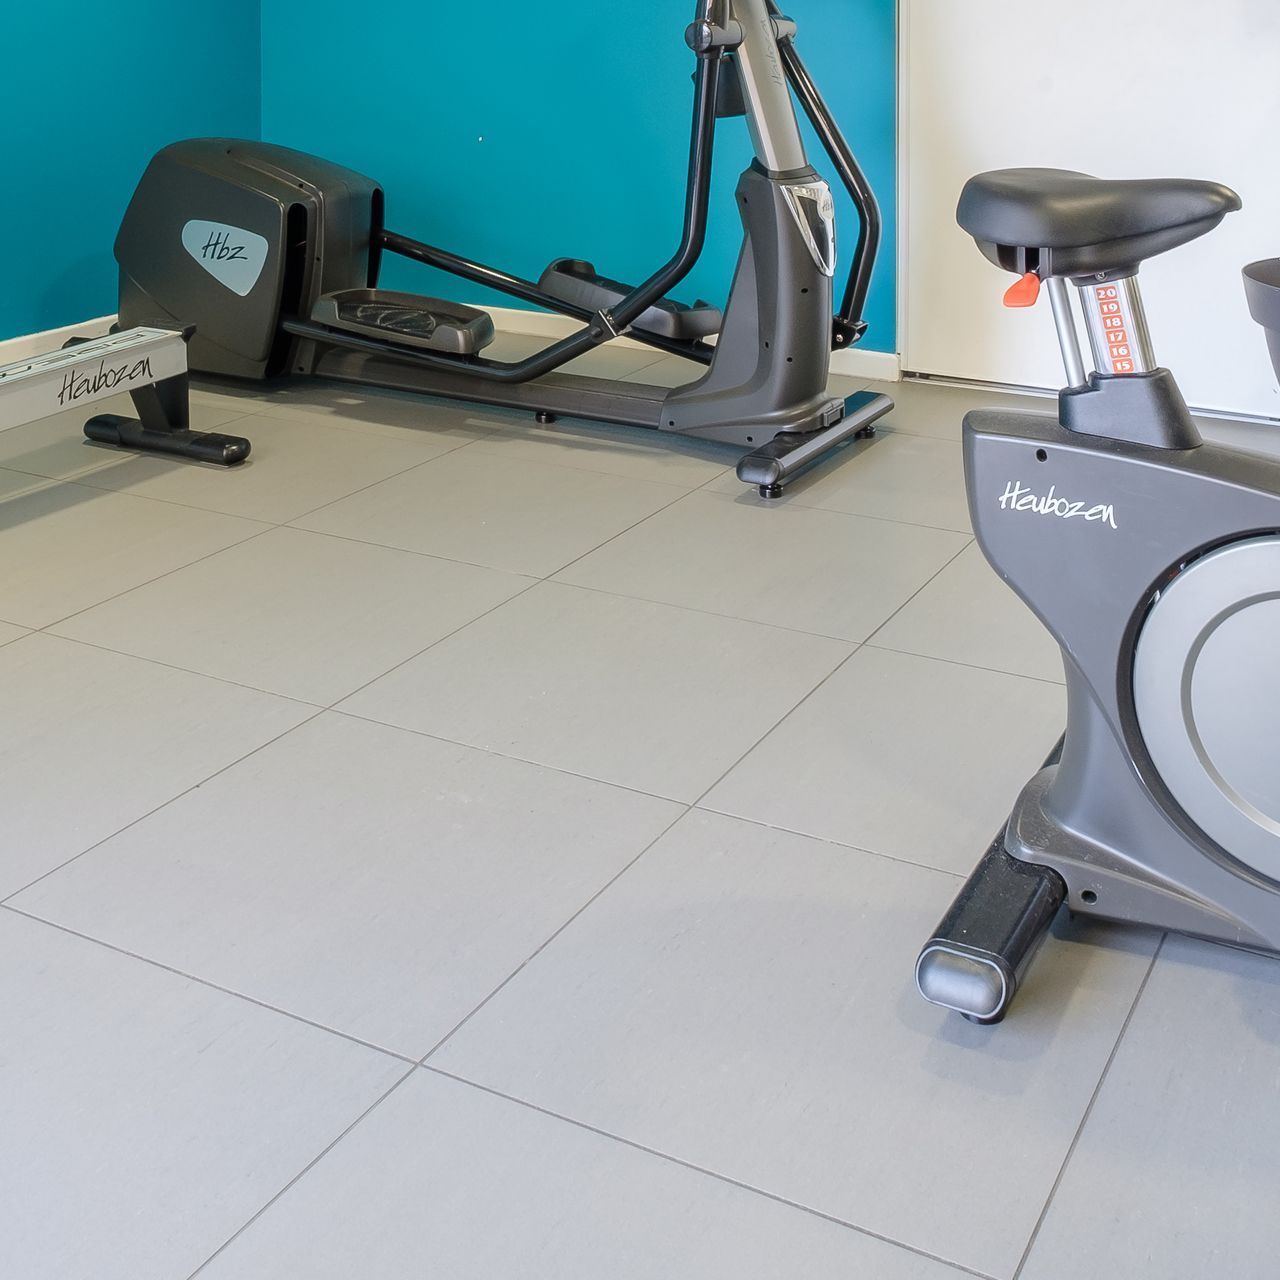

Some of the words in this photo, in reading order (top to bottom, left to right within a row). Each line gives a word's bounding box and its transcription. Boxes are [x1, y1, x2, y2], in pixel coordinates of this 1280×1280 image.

[201, 231, 249, 261] Hbz
[1097, 288, 1117, 299] 20
[1102, 302, 1119, 313] 19
[1105, 317, 1122, 327] 18
[1108, 331, 1124, 342] 17
[1111, 346, 1128, 357] 16
[1115, 361, 1131, 371] 15
[57, 356, 154, 406] Heubozen
[998, 480, 1118, 530] Heubozen
